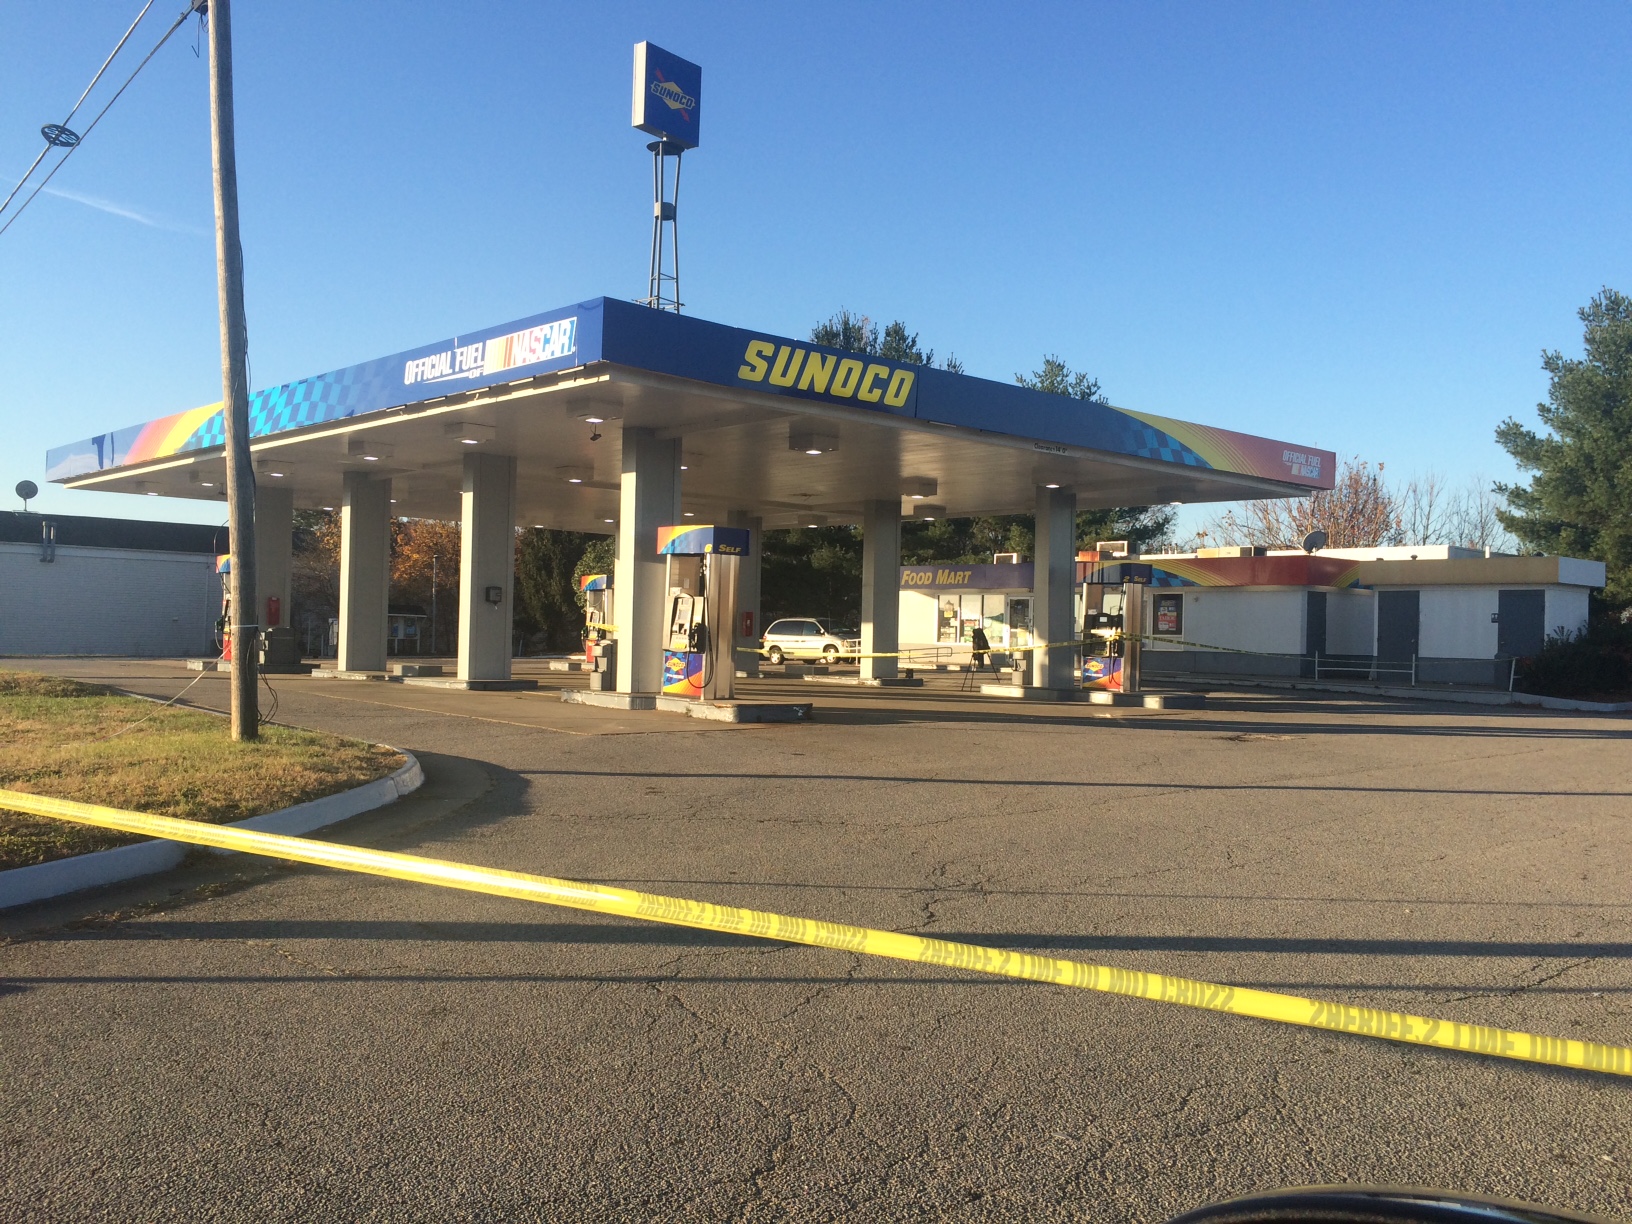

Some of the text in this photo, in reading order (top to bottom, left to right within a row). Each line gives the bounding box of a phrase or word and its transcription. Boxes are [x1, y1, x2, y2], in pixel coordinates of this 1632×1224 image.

[652, 83, 694, 109] SUNOCO
[511, 319, 574, 366] NASCAR
[404, 342, 485, 385] OFFICIAL FUEL
[468, 369, 484, 379] OF
[738, 340, 915, 407] SUNOCO
[1283, 450, 1321, 468] OFFICIAL FUEL
[901, 569, 971, 585] FOOD MART
